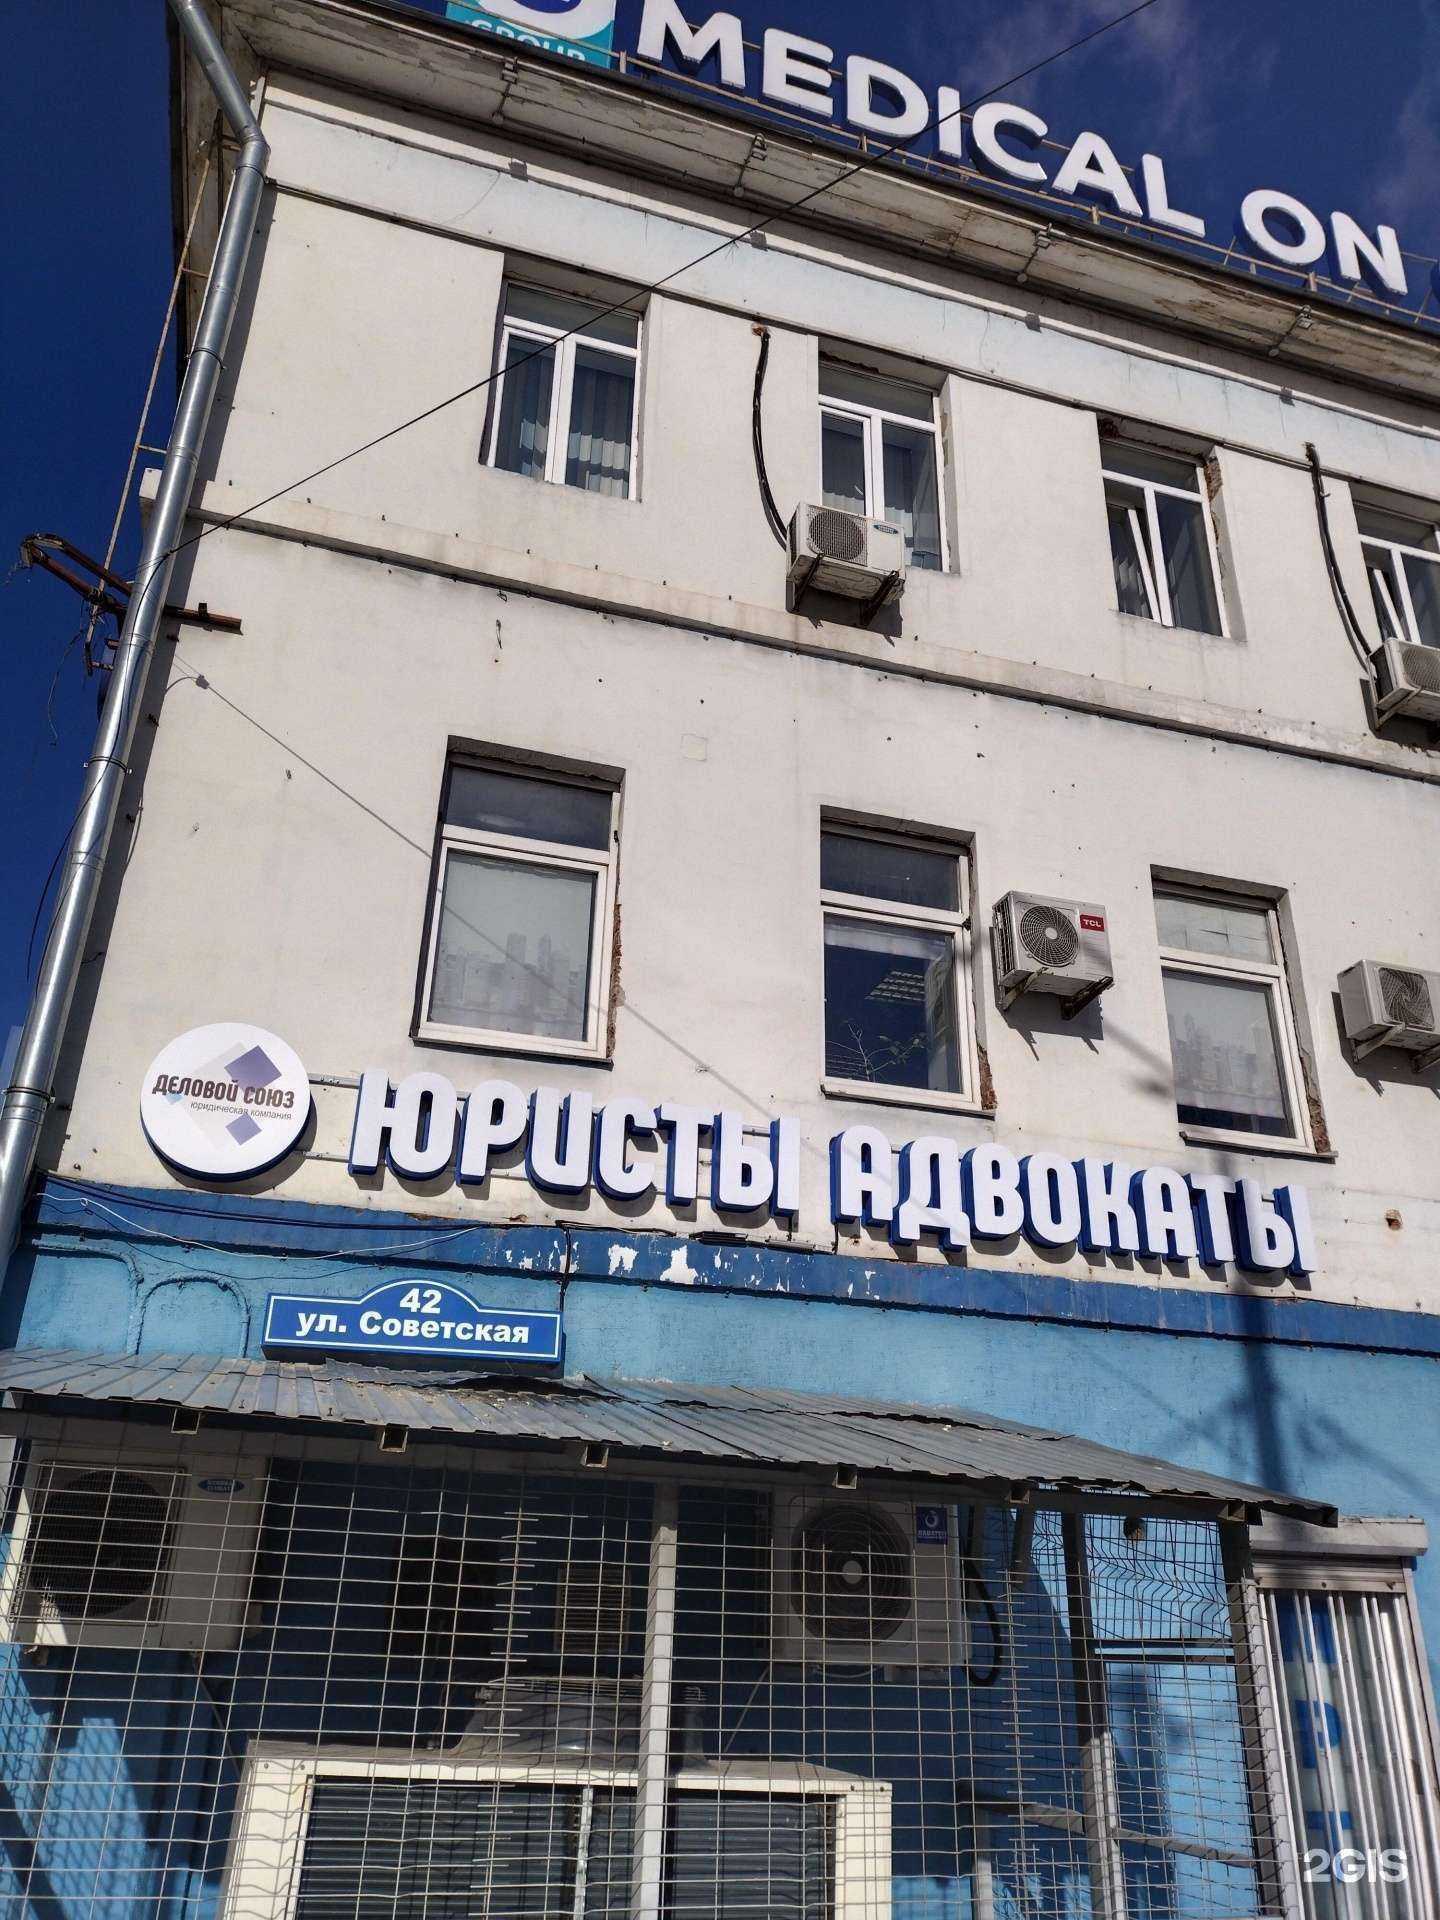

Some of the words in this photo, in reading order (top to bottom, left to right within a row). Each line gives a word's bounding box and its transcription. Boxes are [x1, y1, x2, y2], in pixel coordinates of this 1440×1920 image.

[636, 0, 1205, 237] MEDICAL
[1241, 189, 1409, 295] ON
[1083, 919, 1101, 928] TCL
[152, 1074, 239, 1102] ДЕЛОВОЙ
[243, 1086, 295, 1109] СОЮЗ
[190, 1101, 249, 1116] юридическая
[250, 1108, 292, 1121] компания
[349, 1071, 799, 1213] ЮРИСТЫ
[831, 1126, 1316, 1276] АДВОКАТЫ
[399, 1287, 442, 1314] 42
[295, 1312, 347, 1337] ул.
[359, 1311, 530, 1344] Советская
